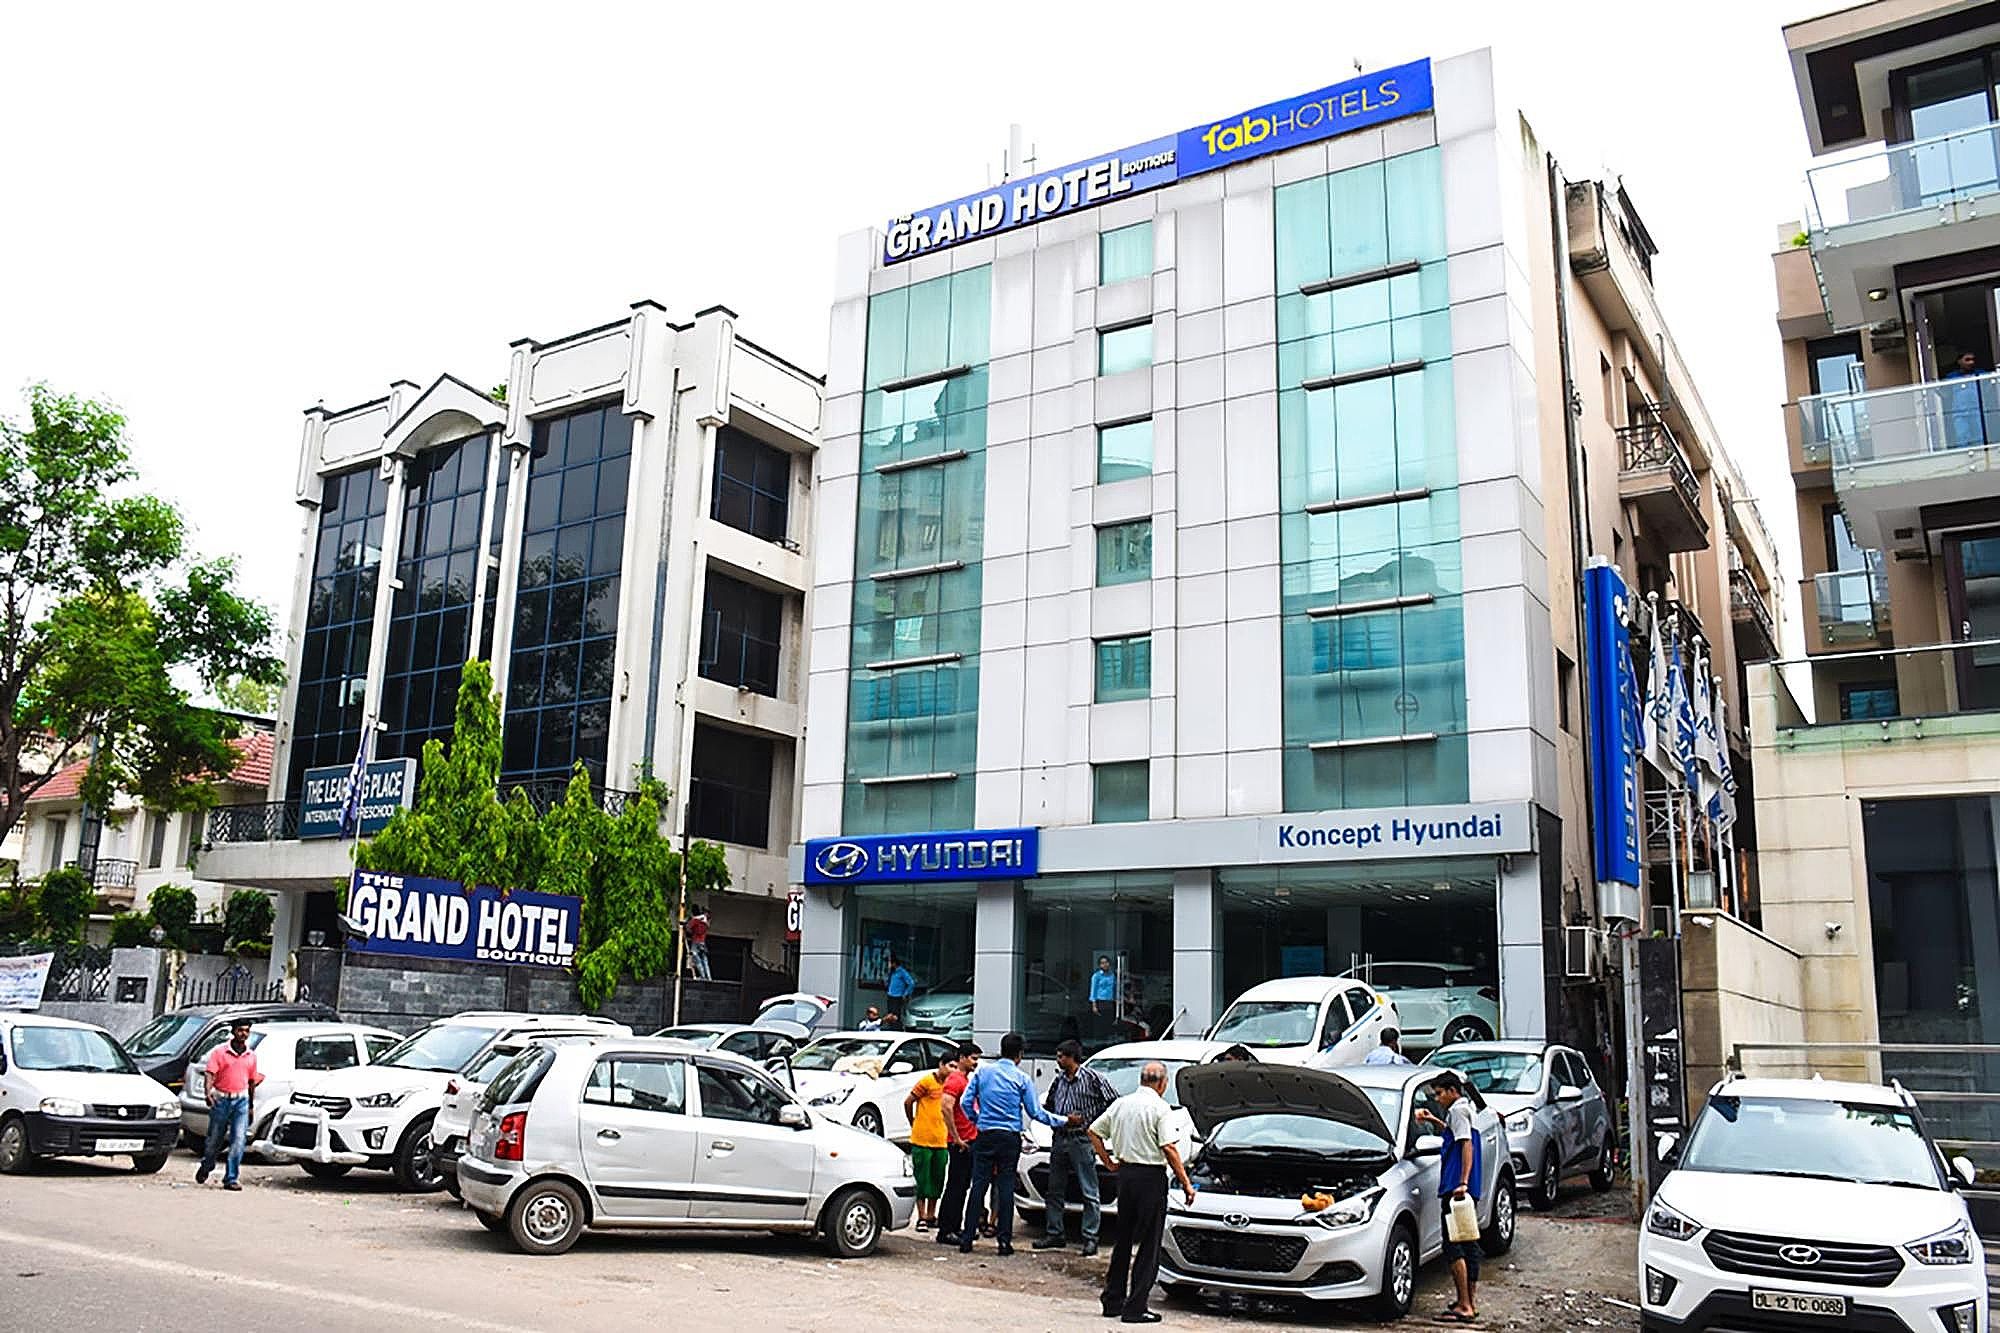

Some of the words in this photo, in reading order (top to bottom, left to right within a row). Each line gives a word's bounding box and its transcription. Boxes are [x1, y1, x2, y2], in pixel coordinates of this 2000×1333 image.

[1122, 150, 1177, 176] BOUTIQUE
[886, 193, 1006, 259] GRAND
[1011, 157, 1133, 222] HOTEL
[306, 779, 325, 804] THE
[370, 771, 403, 798] PLACE
[1278, 823, 1382, 848] Koncept
[1391, 814, 1502, 846] Hyundai
[877, 839, 1023, 872] HYUNDAI
[359, 872, 405, 889] THE
[351, 885, 470, 945] GRAND
[476, 900, 574, 955] HOTEL
[476, 948, 573, 966] BOUTIQUE
[1755, 1293, 1772, 1308] DL
[1775, 1296, 1788, 1309] 12
[1791, 1297, 1808, 1311] TC
